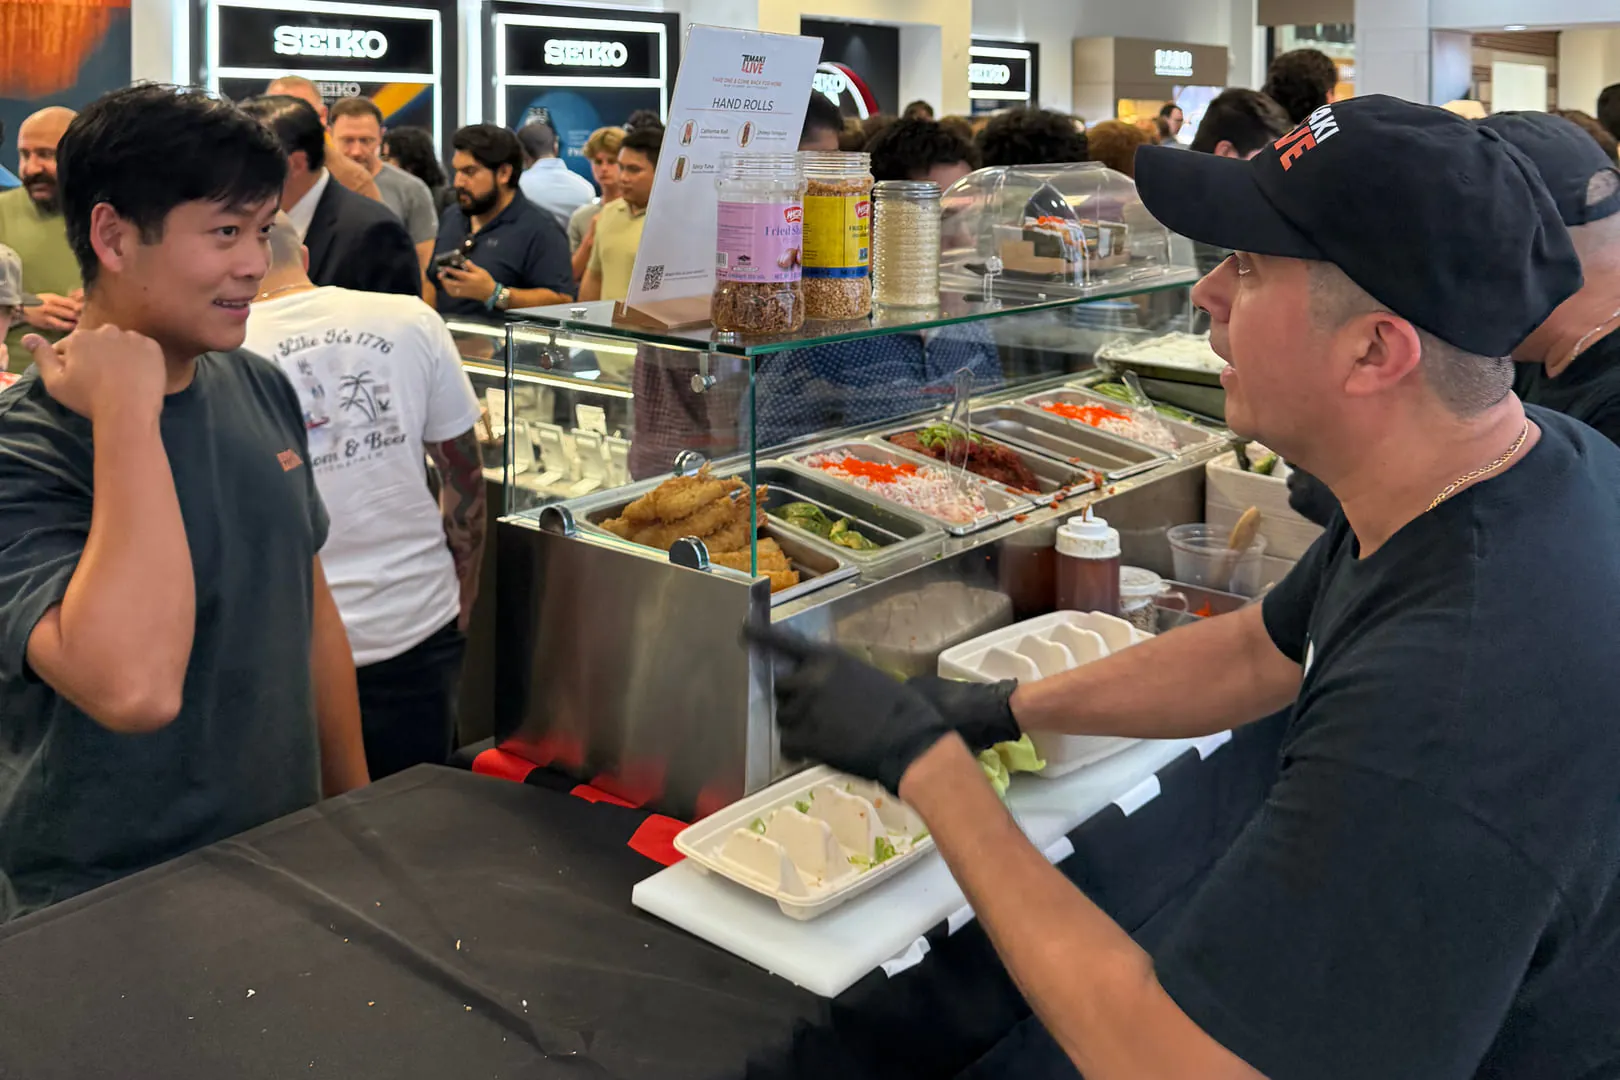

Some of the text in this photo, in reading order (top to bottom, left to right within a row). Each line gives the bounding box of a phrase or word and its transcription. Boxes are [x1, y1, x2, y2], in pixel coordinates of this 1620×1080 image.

[274, 25, 388, 59] SEIKO
[544, 39, 628, 67] SEIKO
[316, 82, 361, 98] EIKO
[712, 97, 774, 111] HAND ROLLS
[1308, 104, 1340, 144] AKI
[1274, 124, 1317, 172] VE
[765, 224, 791, 236] Fried
[357, 331, 394, 354] 1776
[345, 438, 360, 458] &
